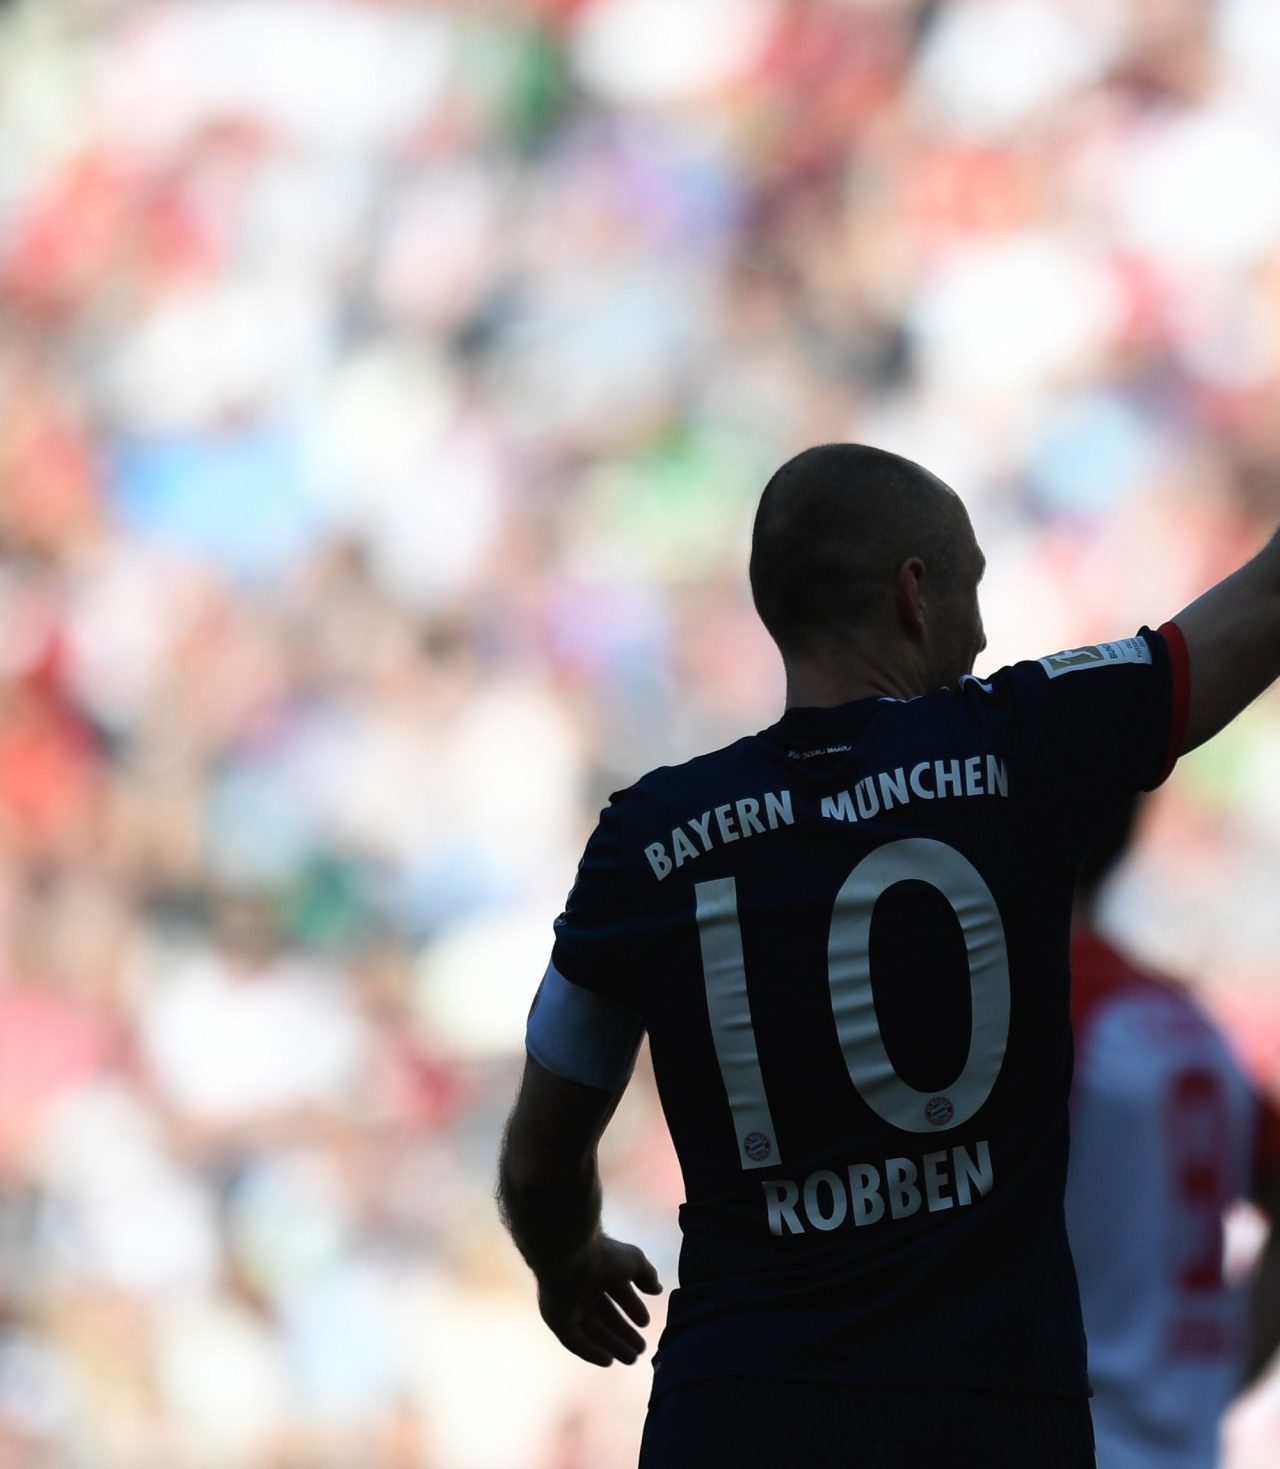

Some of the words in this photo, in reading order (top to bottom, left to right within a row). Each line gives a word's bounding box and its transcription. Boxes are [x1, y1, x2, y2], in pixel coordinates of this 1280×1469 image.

[644, 790, 795, 881] BAYERN
[821, 755, 1008, 823] MÜNCHEN
[695, 838, 1011, 1170] 10
[762, 1140, 994, 1236] ROBBEN
